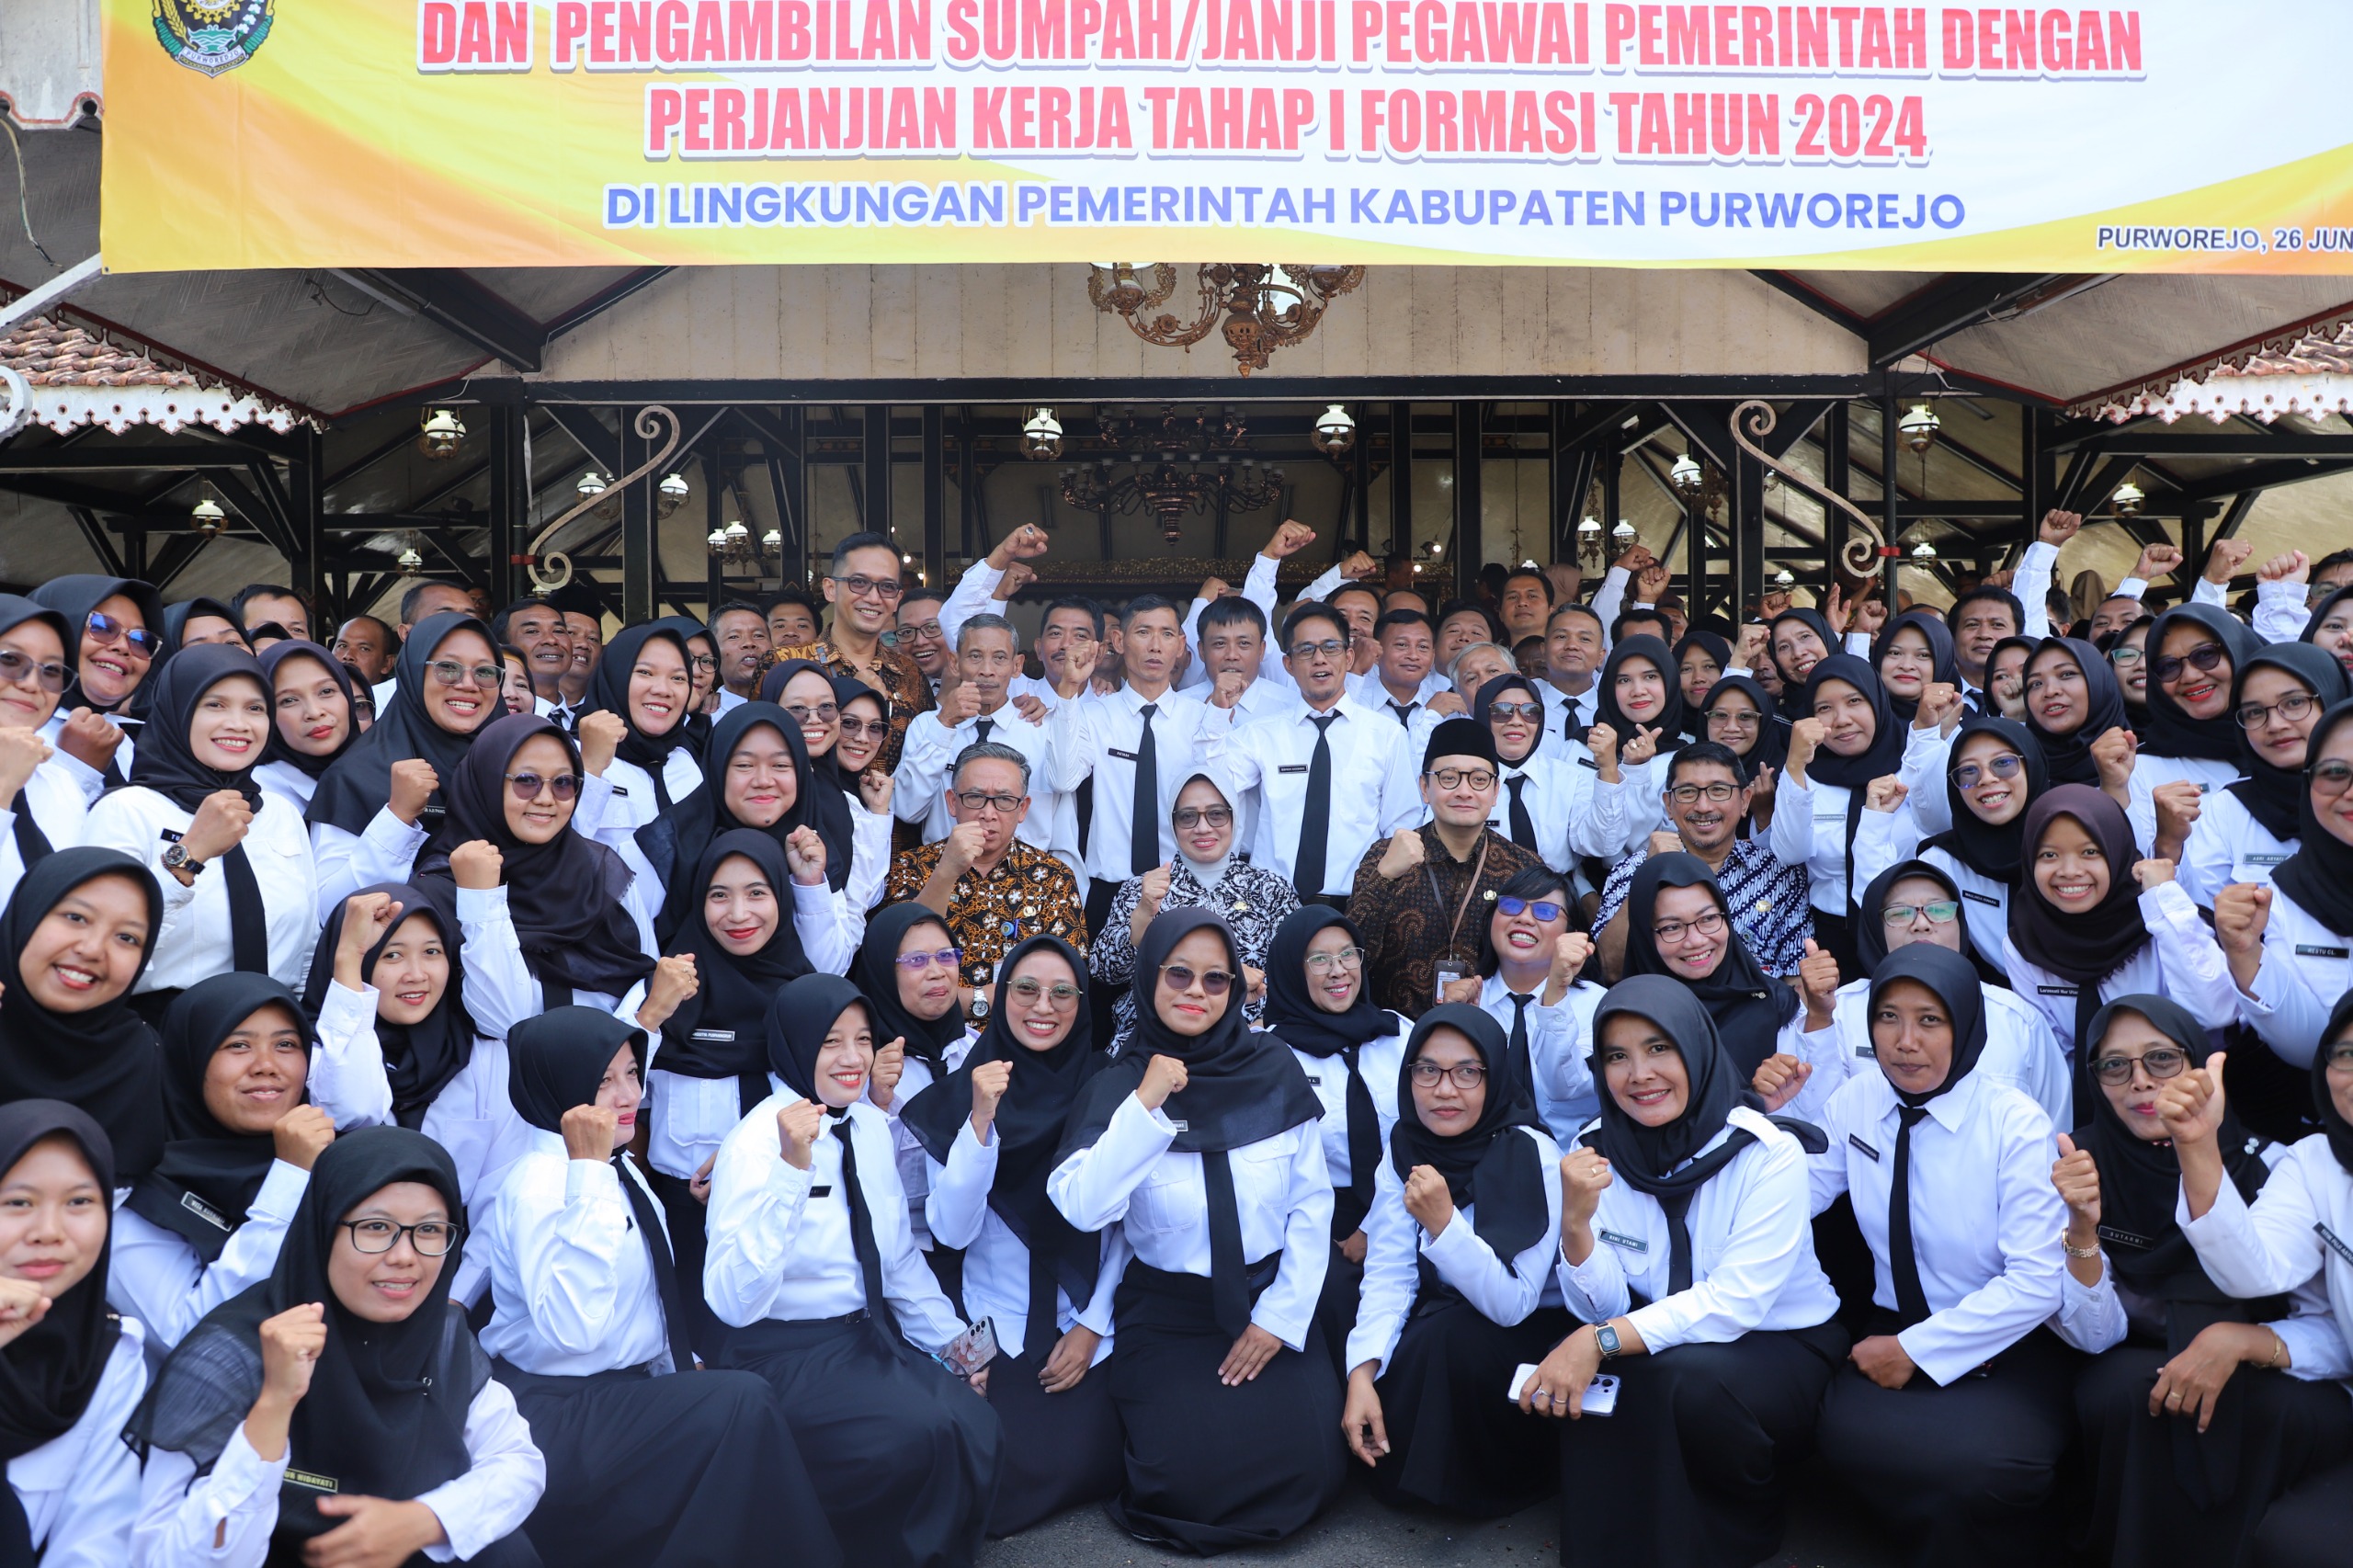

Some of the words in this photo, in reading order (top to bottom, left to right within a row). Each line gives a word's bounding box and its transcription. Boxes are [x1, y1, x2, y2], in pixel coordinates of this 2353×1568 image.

[186, 50, 239, 64] PURWOREDJO
[424, 2, 527, 62] DAN
[557, 0, 930, 62] PENGAMBILAN
[948, 0, 1335, 62] SUMPAH/JANJI
[1353, 0, 1588, 64] PEGAWAI
[1607, 4, 1927, 69] PEMERINTAH
[1943, 8, 2141, 71] DENGAN
[651, 87, 955, 150] PERJANJIAN
[974, 87, 1131, 148] KERJA
[1145, 87, 1313, 149] TAHAP
[1331, 90, 1344, 150] I
[1362, 89, 1596, 153] FORMASI
[1610, 93, 1779, 155] TAHUN
[1795, 94, 1927, 156] 2024
[608, 188, 654, 223] DI
[670, 186, 1002, 223] LINGKUNGAN
[1019, 186, 1335, 223] PEMERINTAH
[1351, 188, 1645, 226] KABUPATEN
[1661, 191, 1965, 229] PURWOREJO
[2098, 228, 2268, 252] PURWOREJO,
[2275, 230, 2302, 248] 26
